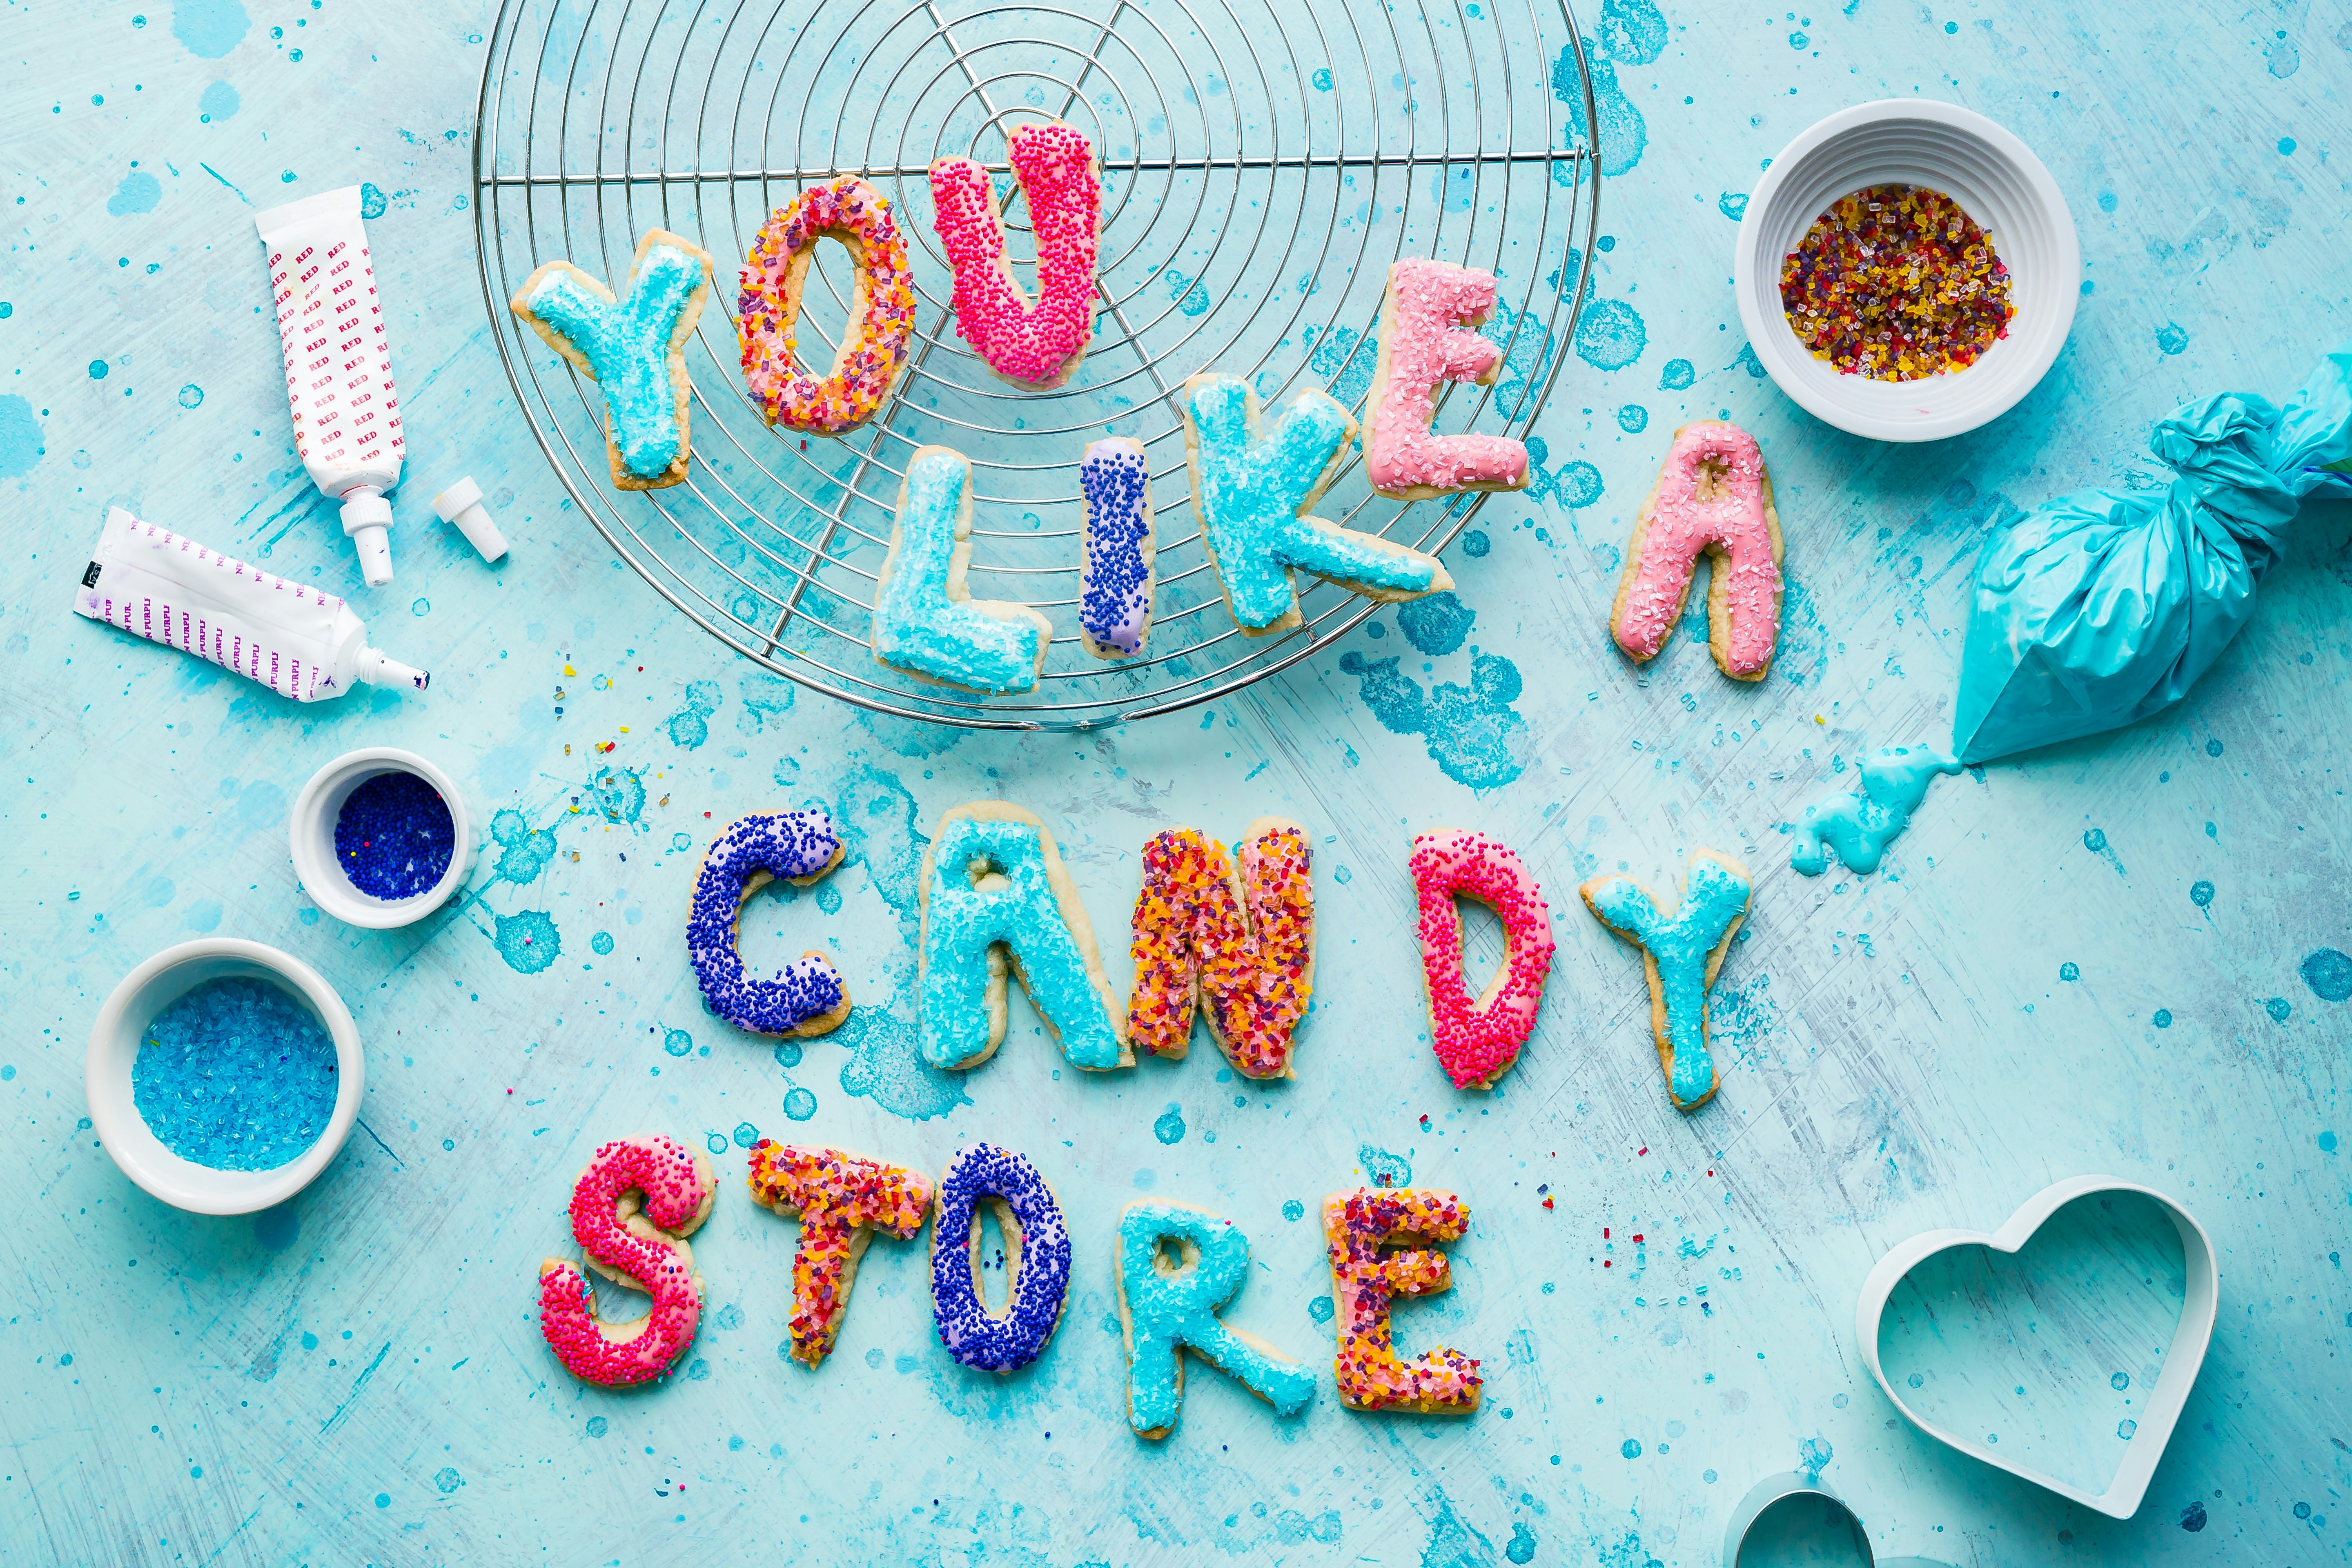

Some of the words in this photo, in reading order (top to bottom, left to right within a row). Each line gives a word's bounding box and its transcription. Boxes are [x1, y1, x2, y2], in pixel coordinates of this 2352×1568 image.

[295, 247, 313, 264] RED
[327, 242, 345, 259] RED
[301, 266, 318, 283] RED
[330, 261, 349, 276] RED
[305, 284, 319, 300] RED
[332, 280, 353, 295] RED
[303, 301, 321, 316] RED
[336, 299, 356, 314] RED
[511, 120, 1102, 492] YOU
[303, 319, 324, 334] RED
[338, 318, 359, 333] RED
[284, 342, 292, 356] ED
[306, 338, 326, 352] RED
[341, 337, 361, 352] RED
[285, 359, 294, 373] ED
[309, 357, 329, 371] RED
[344, 356, 365, 371] RED
[381, 361, 391, 372] RE
[287, 377, 296, 388] ED
[312, 376, 332, 390] RED
[348, 375, 368, 389] RED
[383, 380, 395, 390] RE
[315, 394, 335, 408] RED
[351, 394, 371, 407] RED
[386, 398, 398, 410] RE
[317, 412, 338, 426] RED
[354, 412, 374, 426] RED
[321, 431, 341, 444] RED
[357, 431, 377, 445] RED
[392, 436, 404, 447] RE
[325, 449, 345, 461] RED
[361, 450, 380, 461] RED
[870, 256, 1530, 697] LIKE
[1610, 420, 1785, 682] A
[686, 801, 1753, 1111] CANDY
[539, 1132, 1484, 1439] STORE
